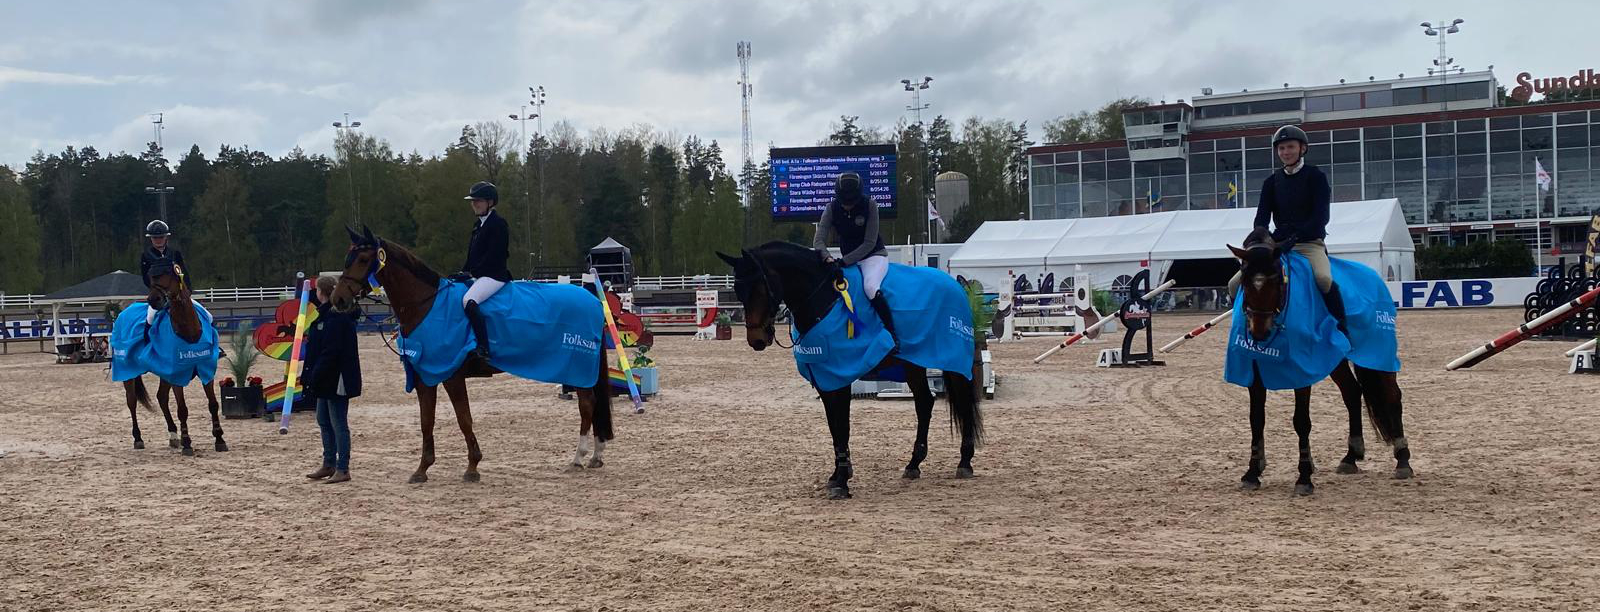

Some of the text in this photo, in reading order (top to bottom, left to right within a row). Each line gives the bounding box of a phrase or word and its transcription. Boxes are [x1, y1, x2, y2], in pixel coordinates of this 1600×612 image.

[1394, 280, 1494, 307] FAB
[179, 349, 210, 359] Folksam
[1100, 352, 1106, 363] A
[1577, 355, 1584, 368] B
